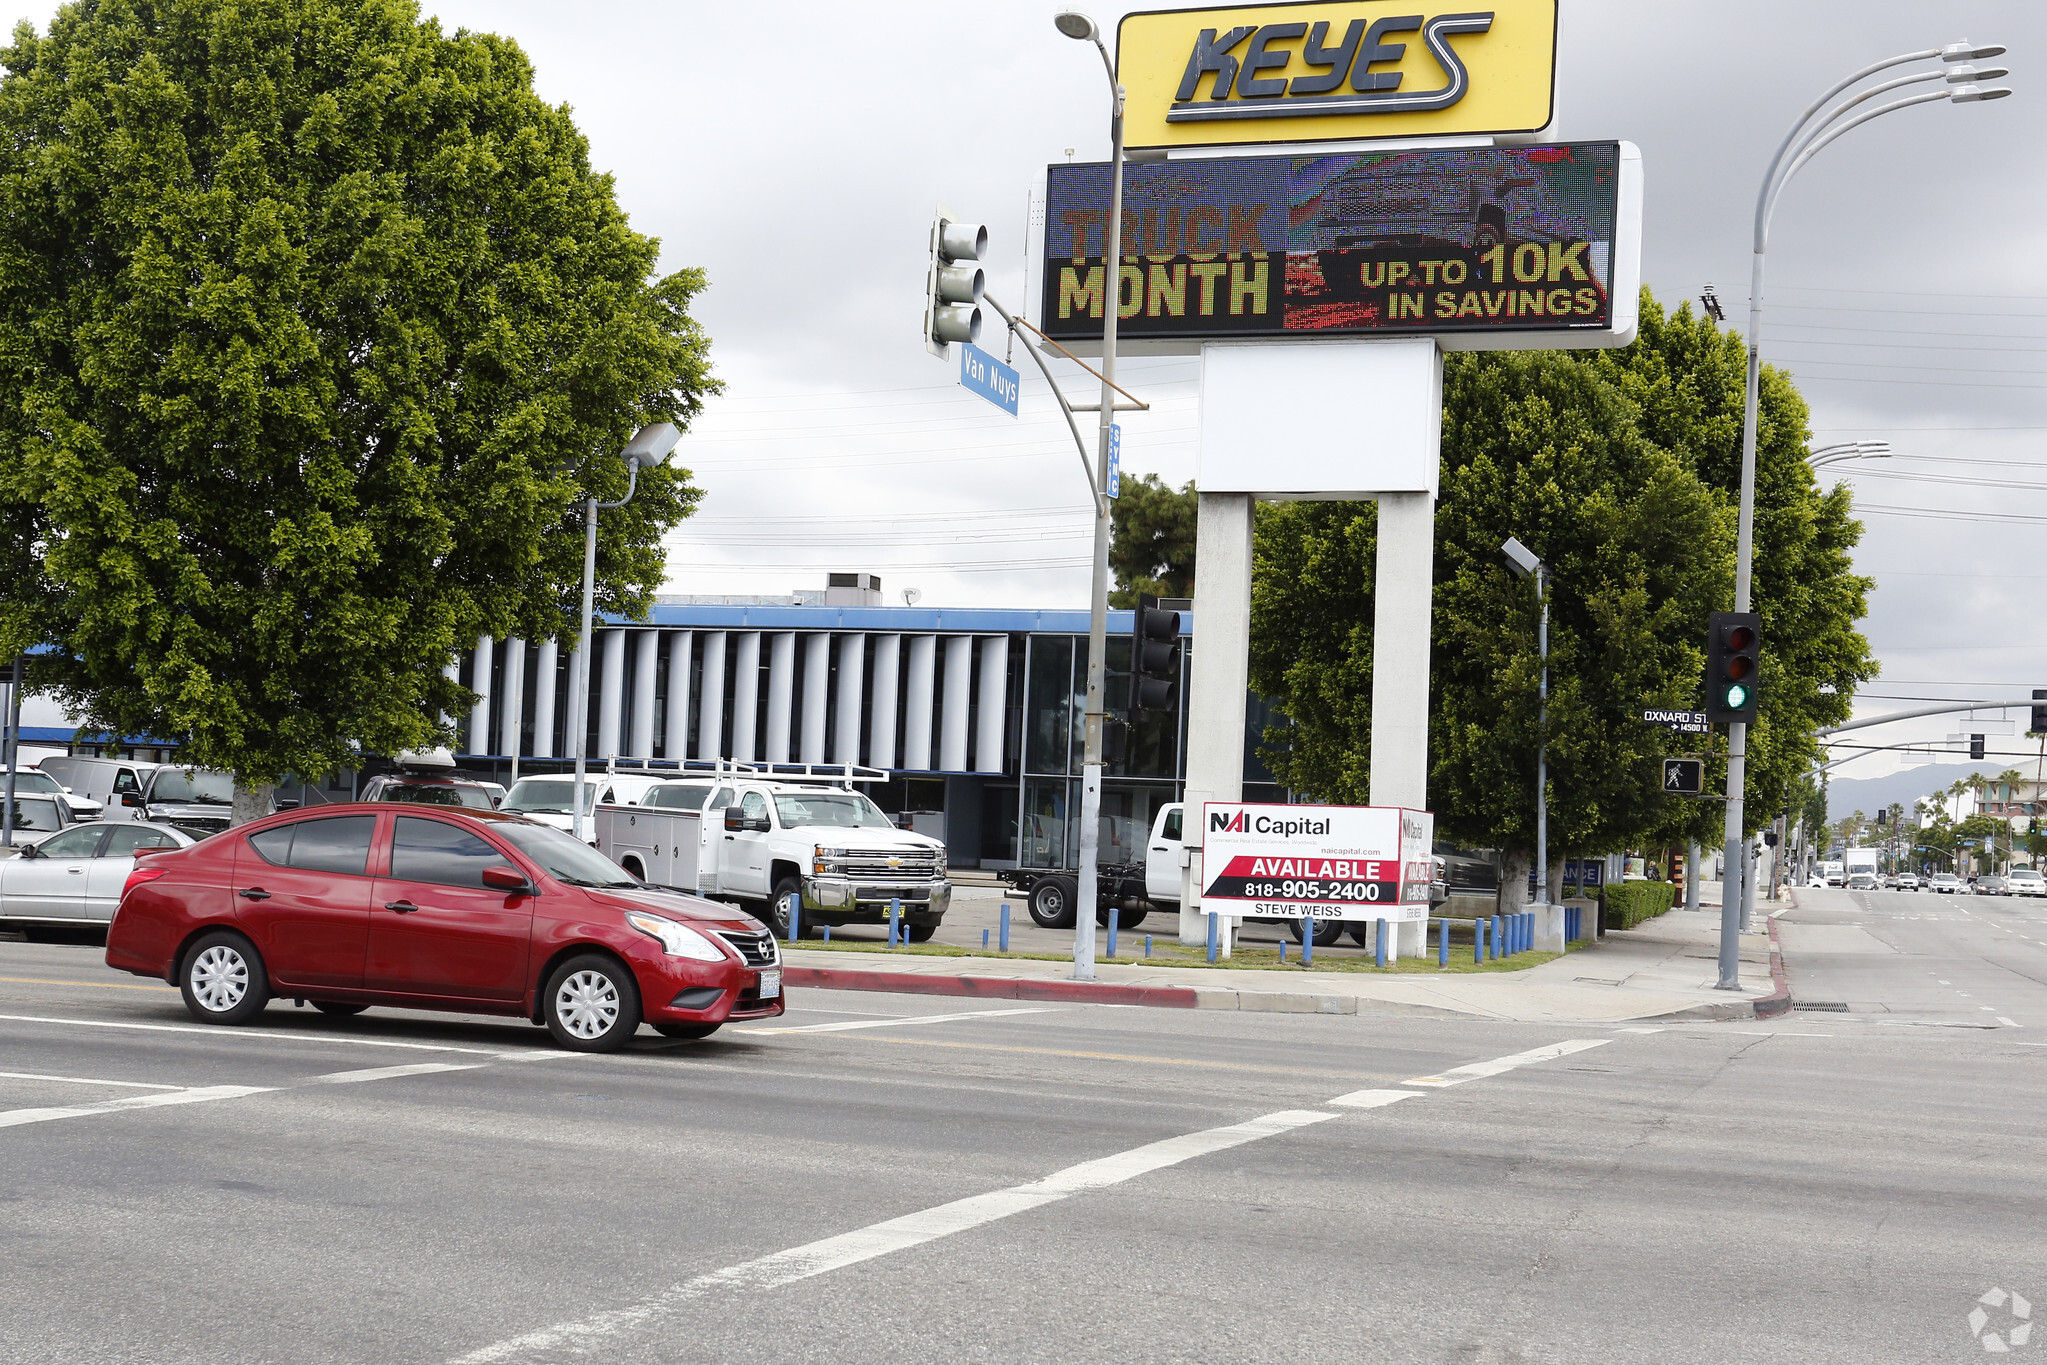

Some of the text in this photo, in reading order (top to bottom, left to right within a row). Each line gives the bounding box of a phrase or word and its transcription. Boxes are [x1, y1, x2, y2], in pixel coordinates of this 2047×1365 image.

[1166, 11, 1496, 124] KEYES
[1062, 203, 1270, 265] TRUCK
[1360, 241, 1590, 288] UP TO 10K
[1058, 261, 1269, 320] MONTH
[1388, 287, 1598, 319] IN SAVINGS
[964, 348, 1016, 403] Van Nuys
[1644, 711, 1690, 723] OXNARD
[1680, 723, 1701, 732] 14500
[1210, 808, 1331, 838] NAI Capital
[1321, 847, 1381, 857] naicapital.com
[1251, 858, 1381, 880] AVAILABLE
[1245, 881, 1380, 901] 818-905-2400
[1255, 903, 1342, 917] STEVE WEISS
